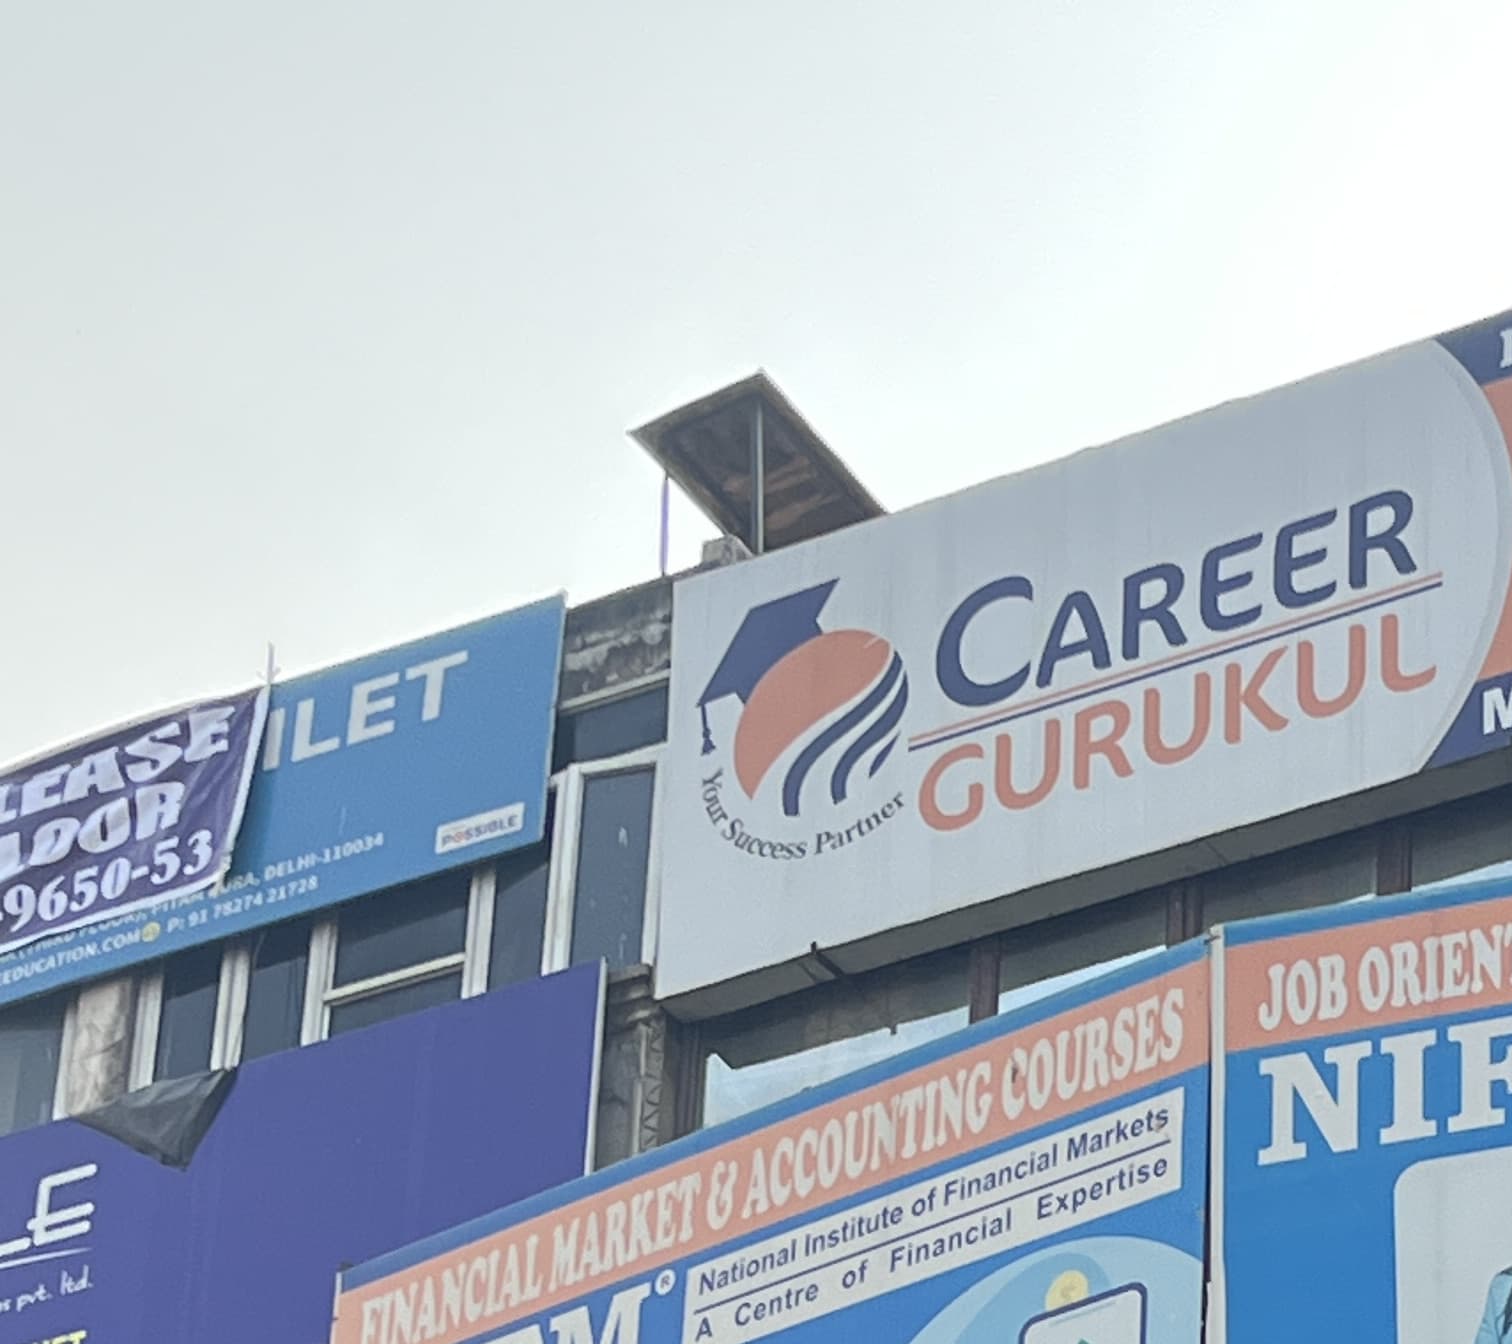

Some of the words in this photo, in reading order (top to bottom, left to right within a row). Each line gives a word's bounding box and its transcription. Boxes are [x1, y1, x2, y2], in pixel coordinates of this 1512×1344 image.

[935, 489, 1418, 708] CAREER
[701, 767, 729, 826] Your
[721, 818, 808, 860] Success
[814, 791, 905, 855] Partner
[918, 613, 1437, 831] GURUKUL
[1258, 952, 1347, 1031] JOB
[551, 1170, 701, 1292] MARKET
[706, 1157, 740, 1230] &
[742, 1068, 994, 1220] ACCOUNTING
[1003, 987, 1185, 1122] COURSES
[699, 1226, 797, 1296] National
[804, 1198, 904, 1260] Institute
[911, 1185, 939, 1221] of
[944, 1142, 1058, 1209] Financial
[1066, 1105, 1170, 1163] Markets
[694, 1316, 714, 1344] A
[734, 1281, 818, 1326] Centre
[841, 1258, 869, 1290] of
[889, 1208, 1012, 1275] Financial
[1036, 1155, 1170, 1224] Expertise
